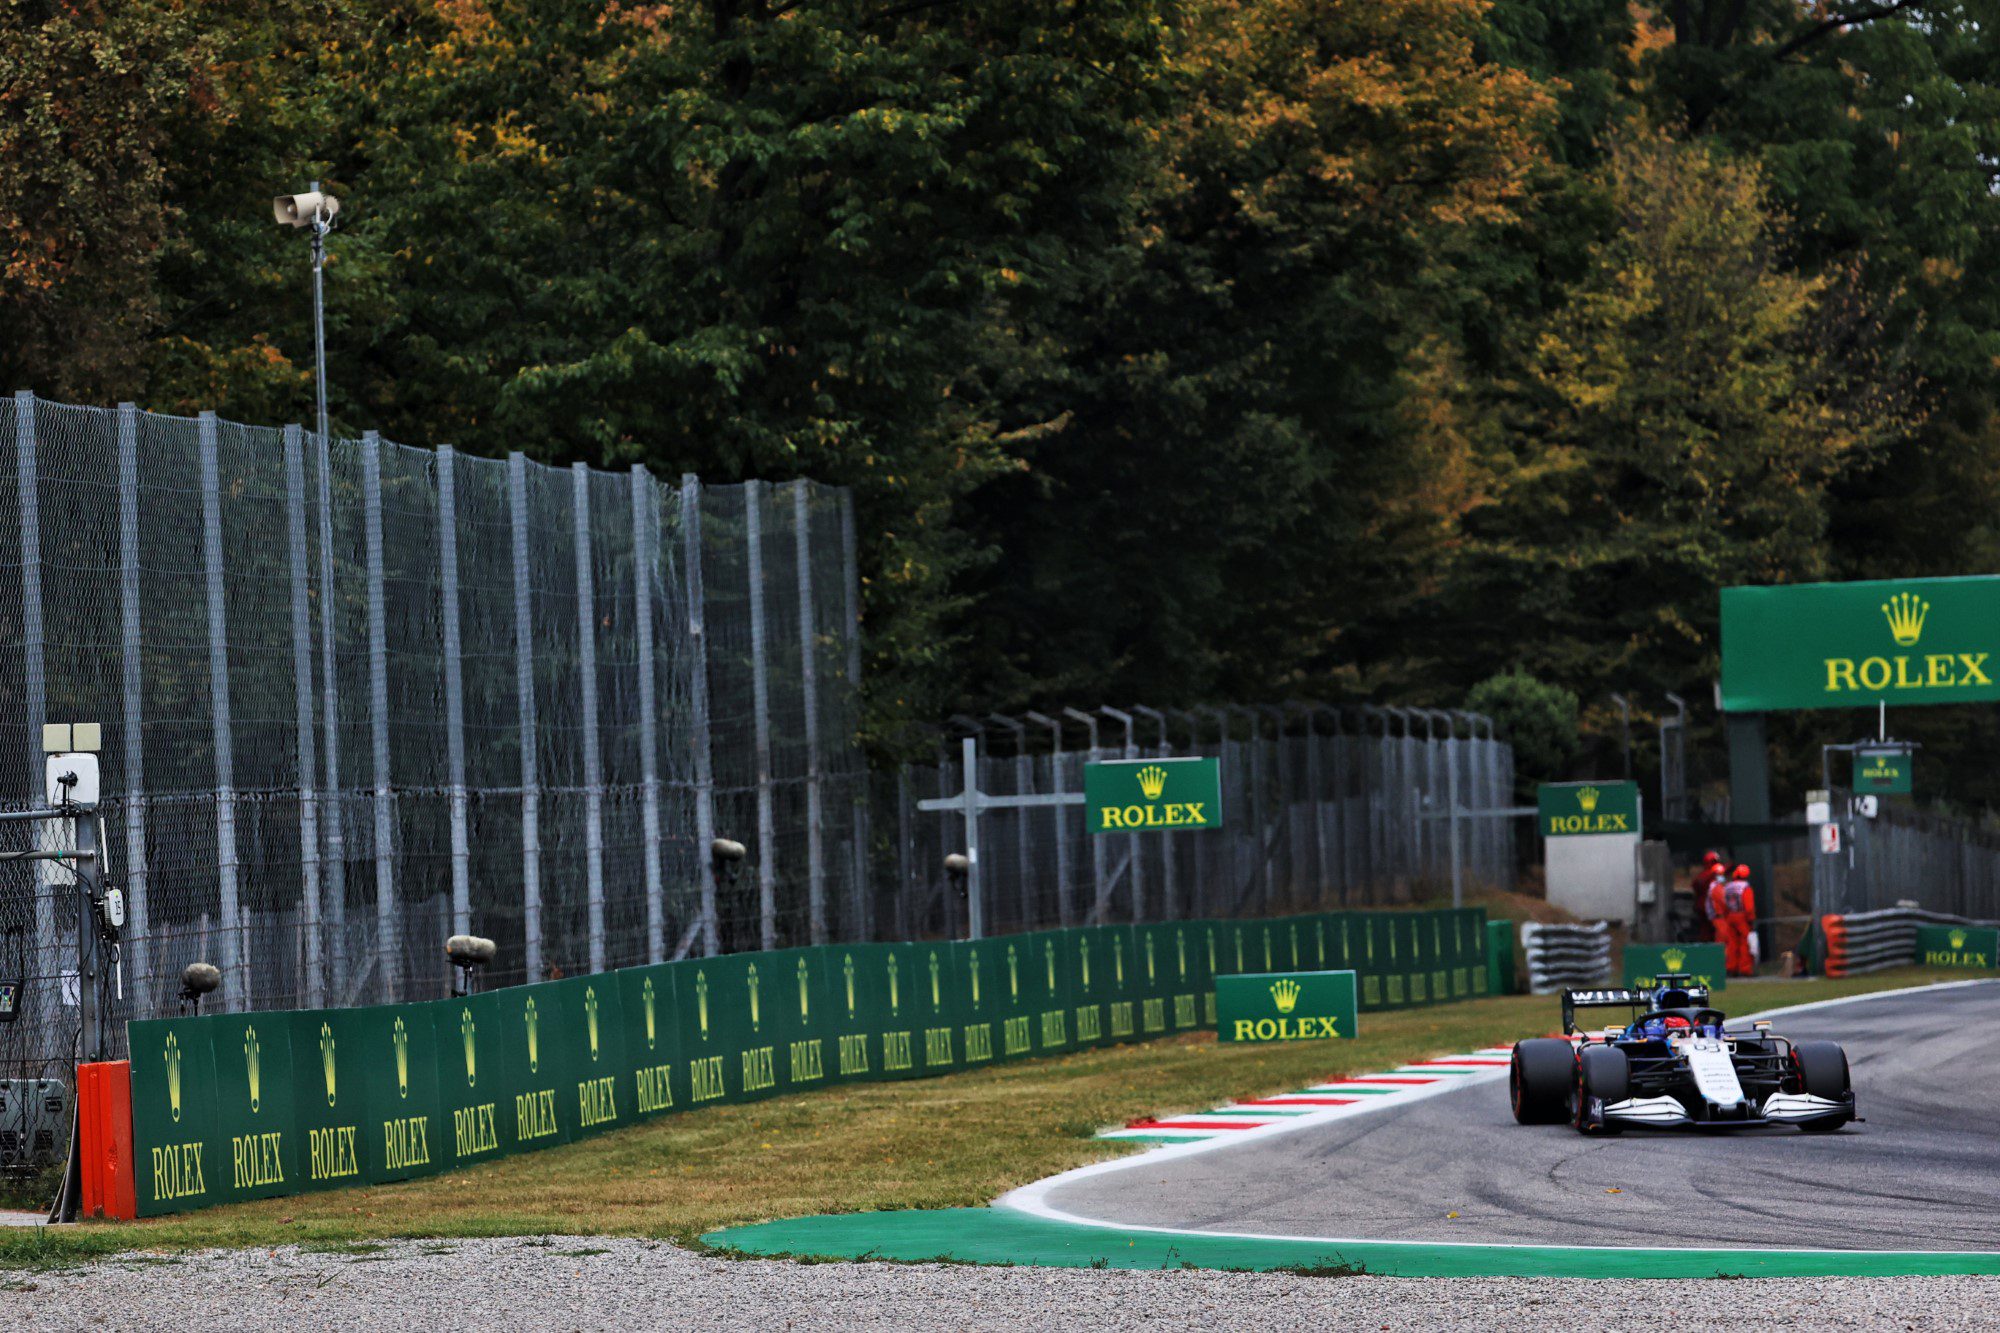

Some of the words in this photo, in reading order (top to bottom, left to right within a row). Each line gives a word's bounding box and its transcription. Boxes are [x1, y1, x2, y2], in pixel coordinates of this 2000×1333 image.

[1825, 653, 1992, 691] ROLEX
[1101, 802, 1207, 828] ROLEX
[1551, 815, 1628, 833] ROLEX
[1926, 951, 1986, 968] ROLEX
[1235, 1016, 1339, 1042] ROLEX
[579, 1077, 617, 1127] ROLEX
[637, 1065, 673, 1112] ROLEX
[690, 1056, 725, 1102] ROLEX
[454, 1104, 498, 1154] ROLEX
[516, 1089, 558, 1141] ROLEX
[232, 1132, 284, 1188] ROLEX
[309, 1126, 358, 1179] ROLEX
[384, 1117, 429, 1167] ROLEX
[152, 1142, 206, 1200] ROLEX
